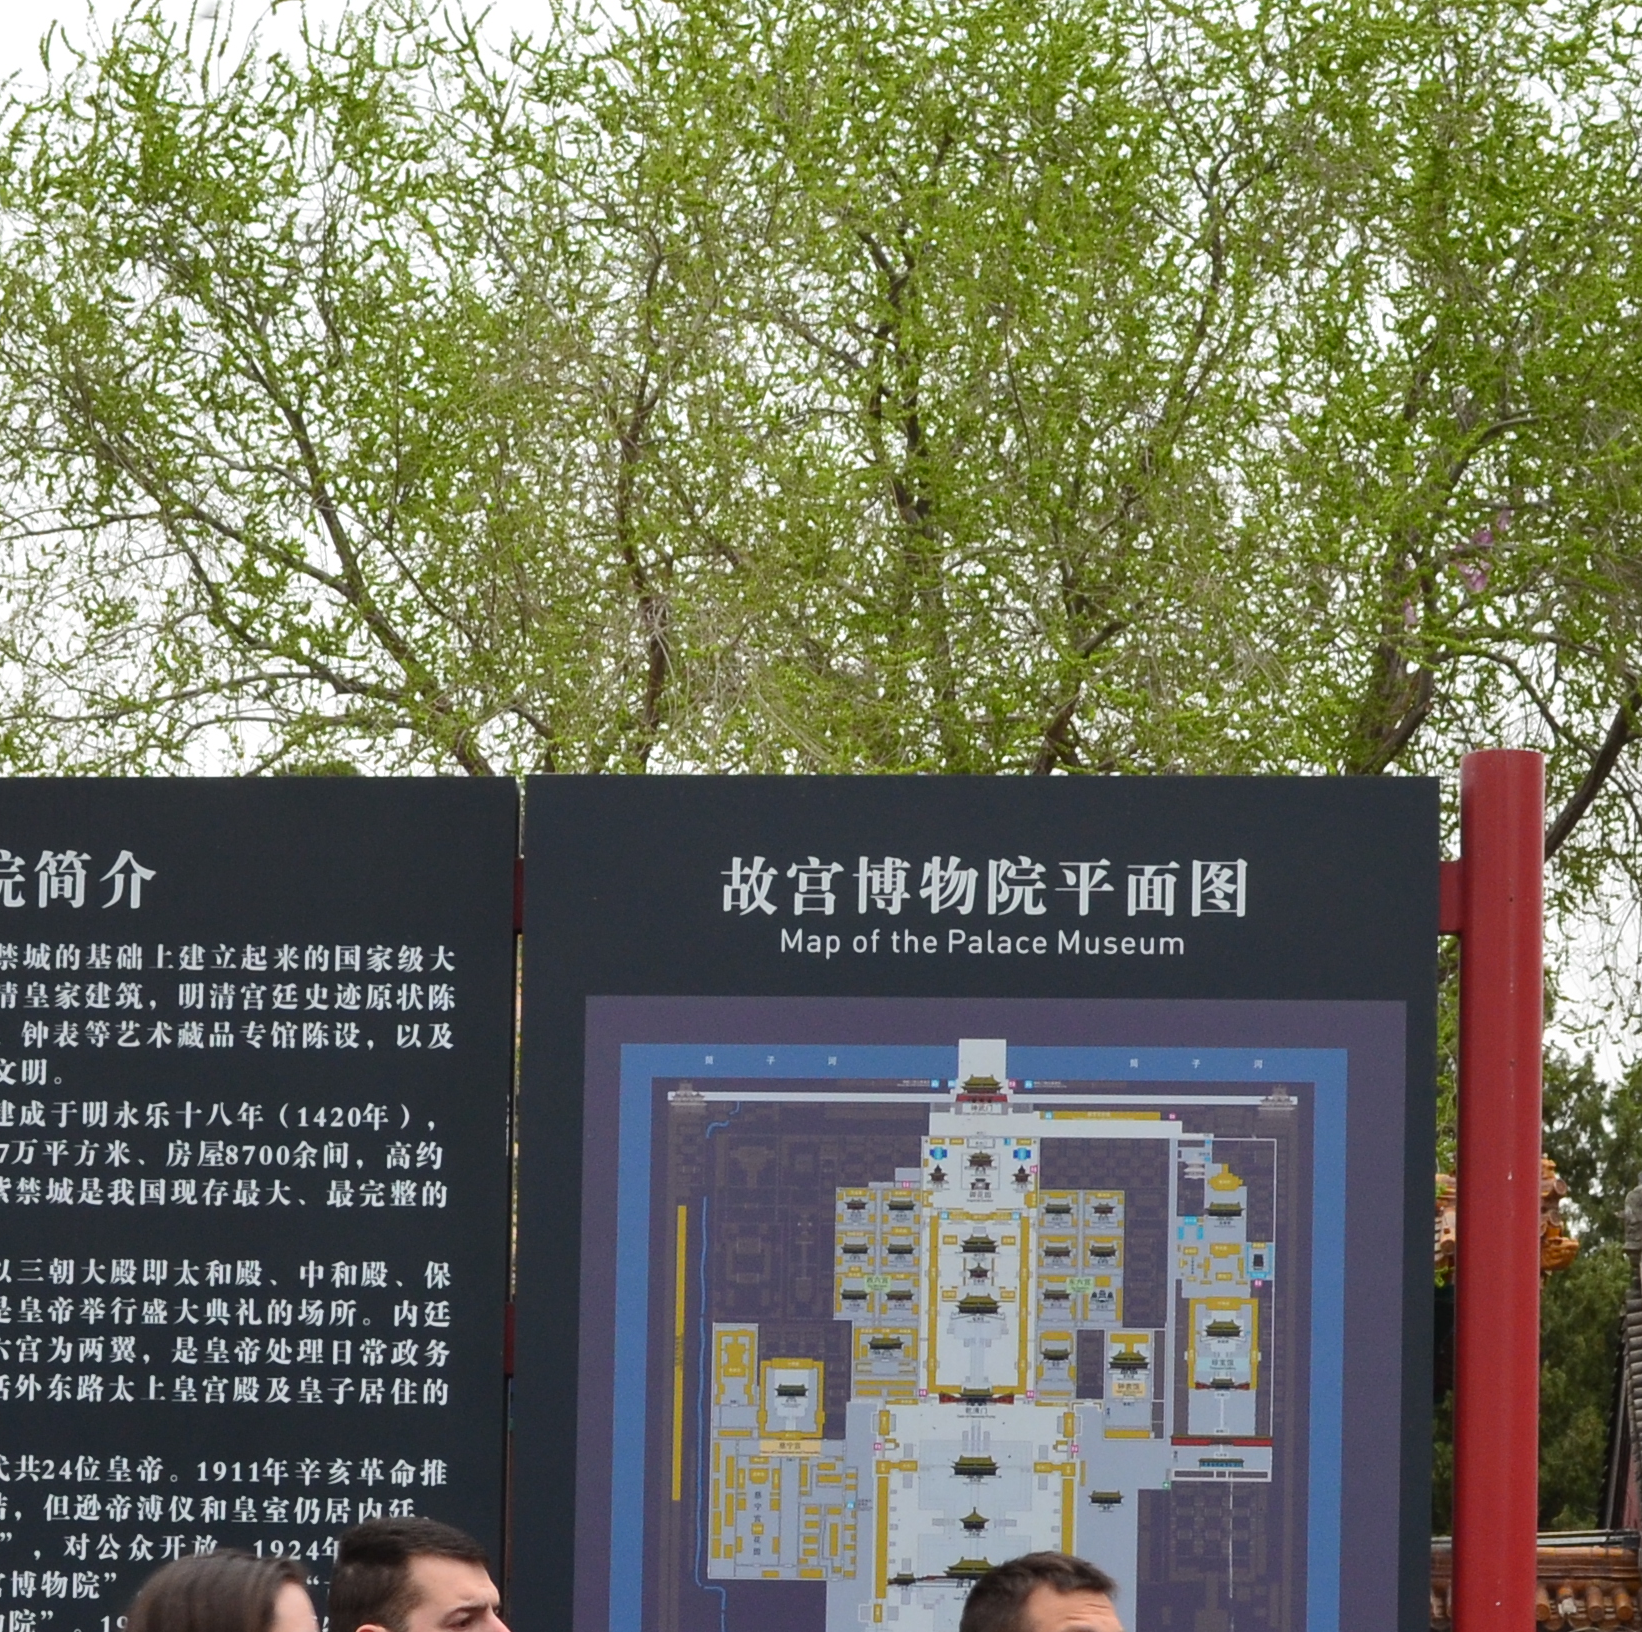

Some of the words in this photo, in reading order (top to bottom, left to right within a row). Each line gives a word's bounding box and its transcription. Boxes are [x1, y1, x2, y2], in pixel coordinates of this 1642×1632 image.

[720, 855, 1248, 918] 故宫博物院平面图
[780, 928, 841, 960] Map
[852, 928, 880, 954] of
[890, 928, 938, 954] the
[948, 928, 1048, 955] Palace
[1058, 929, 1185, 955] Museum
